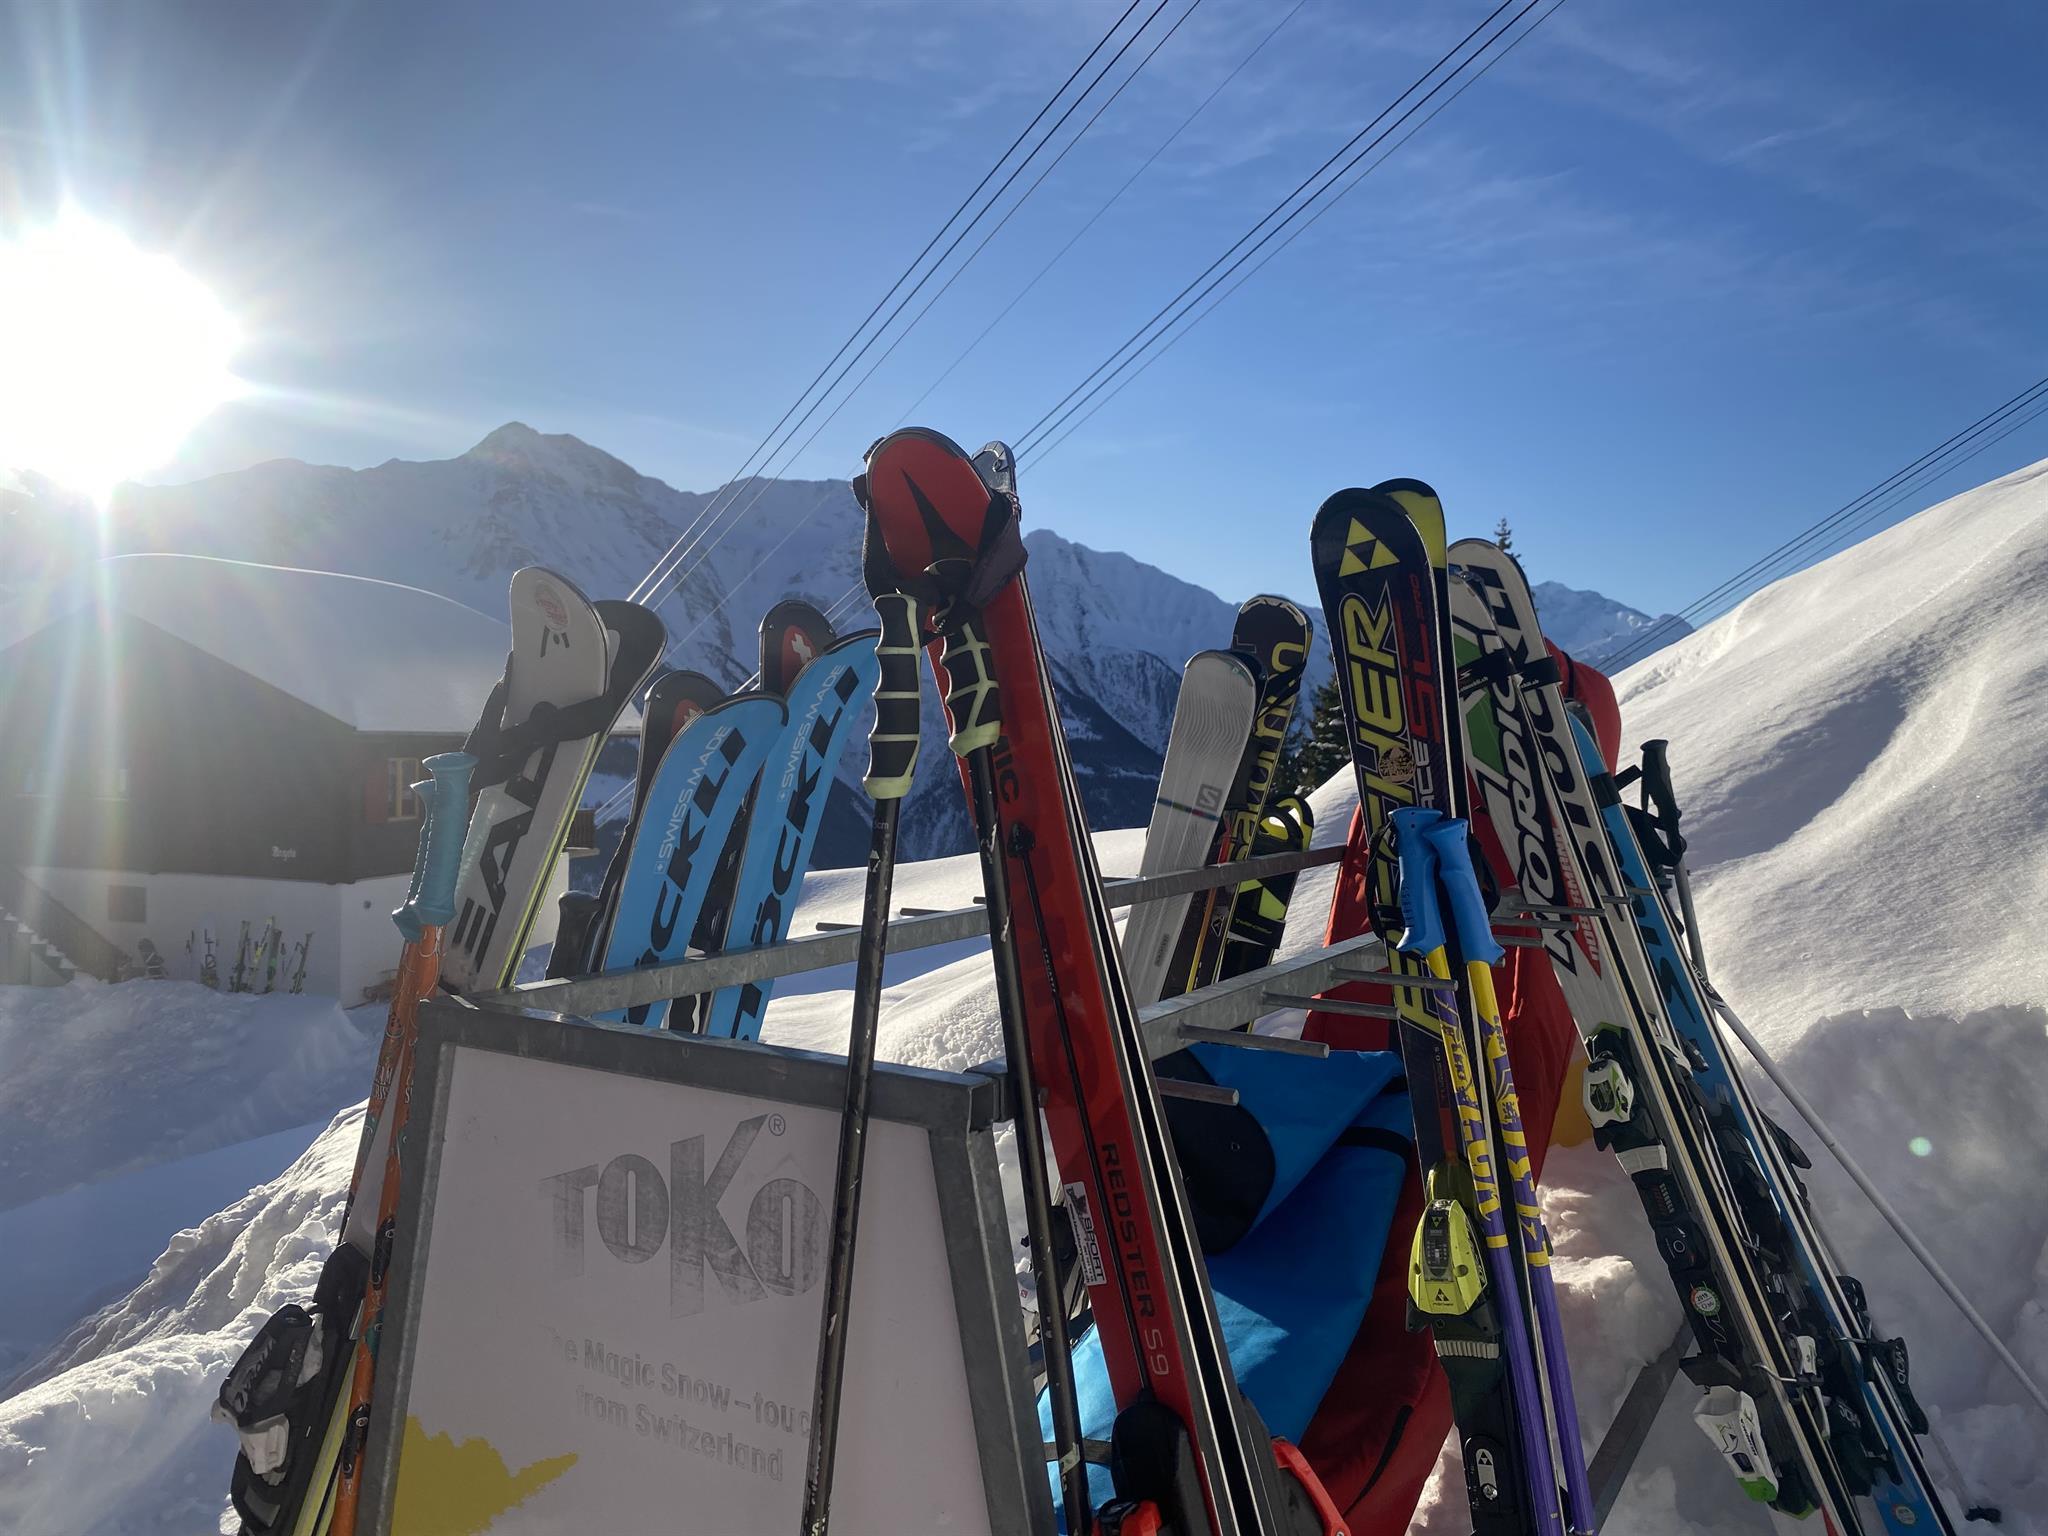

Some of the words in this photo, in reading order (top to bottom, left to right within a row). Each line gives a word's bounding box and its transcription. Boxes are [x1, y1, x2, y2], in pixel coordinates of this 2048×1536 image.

[804, 664, 846, 732] MADE
[658, 803, 688, 862] SWISS
[682, 726, 731, 804] MADE
[1084, 1217, 1105, 1281] SPORT
[1101, 1142, 1155, 1319] REDSTER
[1141, 1328, 1169, 1377] S9
[584, 1338, 655, 1388] Magic
[576, 1384, 629, 1428] from
[635, 1403, 784, 1482] Switzerland
